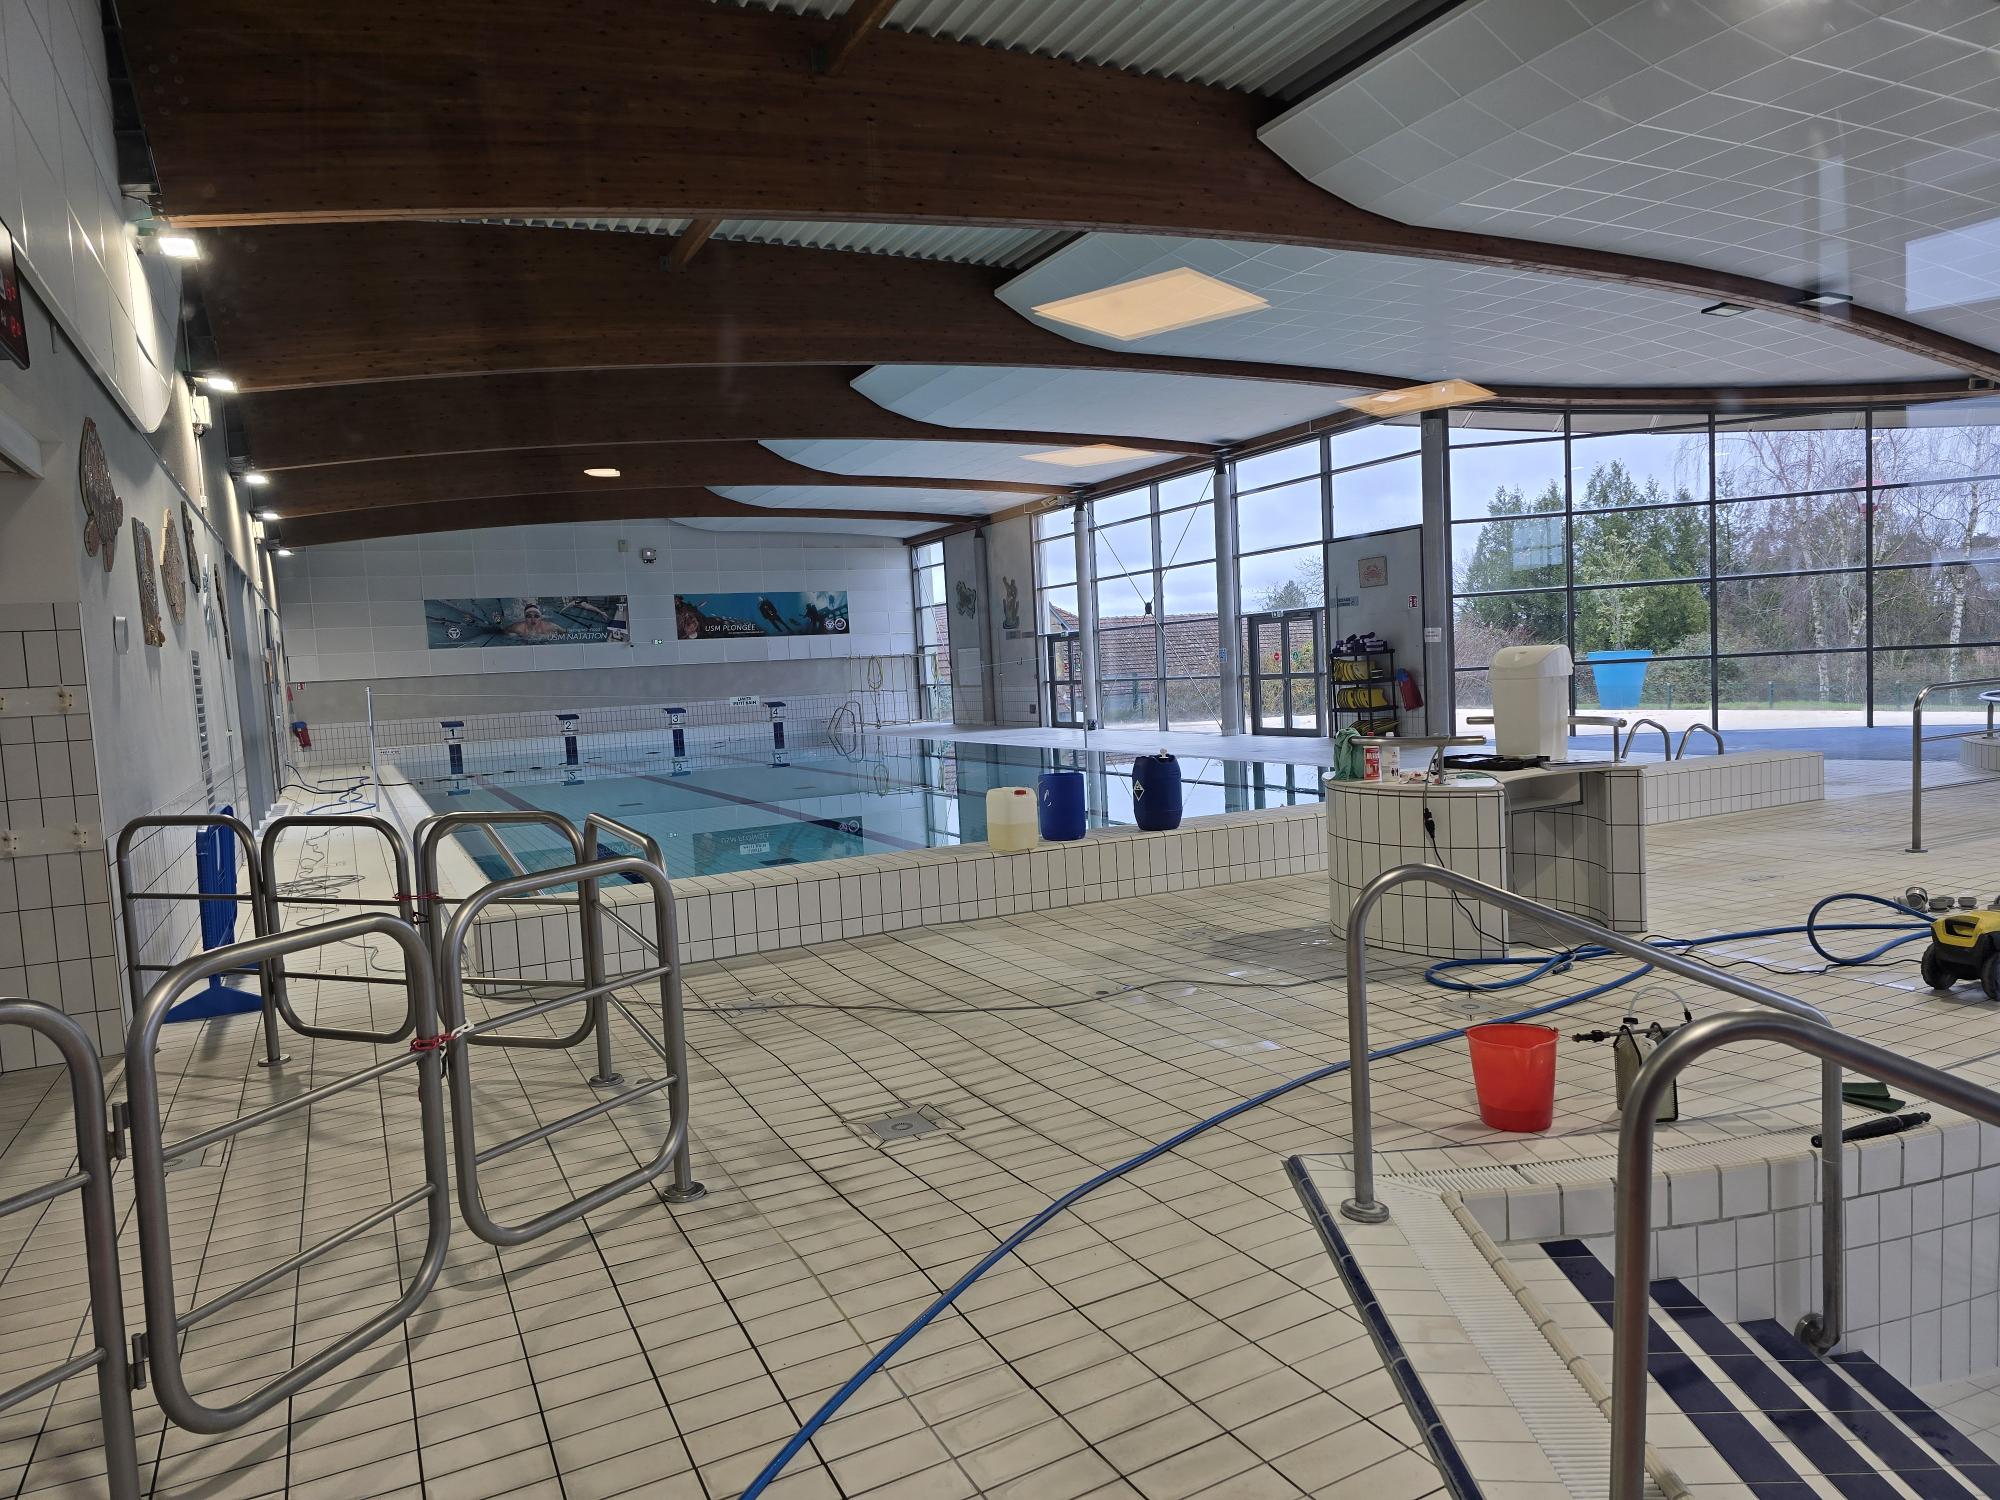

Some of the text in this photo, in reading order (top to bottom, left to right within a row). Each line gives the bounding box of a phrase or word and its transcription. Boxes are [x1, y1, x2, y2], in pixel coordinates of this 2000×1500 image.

[705, 624, 721, 632] USM
[547, 632, 608, 641] USM NATATION
[672, 714, 679, 723] 3
[565, 721, 572, 730] 2
[450, 728, 455, 737] 1
